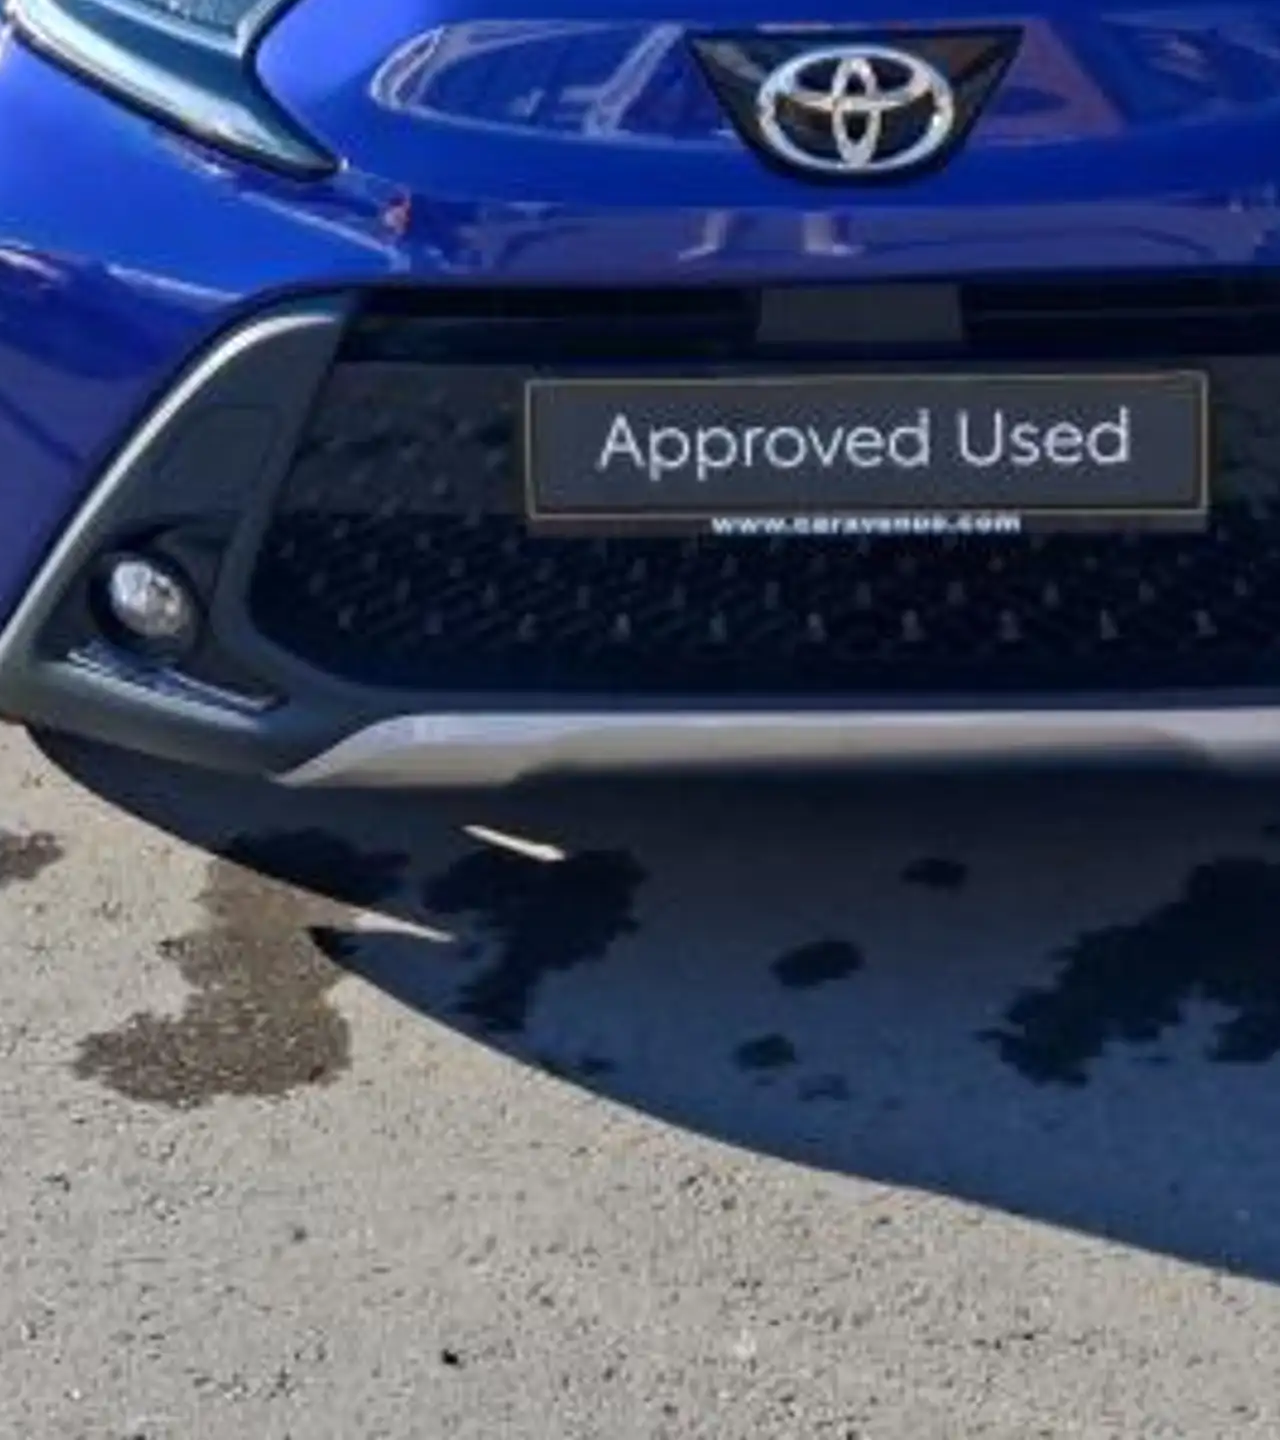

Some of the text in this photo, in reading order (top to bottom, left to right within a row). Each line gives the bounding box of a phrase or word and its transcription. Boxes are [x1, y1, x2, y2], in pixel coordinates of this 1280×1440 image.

[596, 407, 1131, 481] Approved Used
[711, 516, 1021, 536] www.caravenue.com
